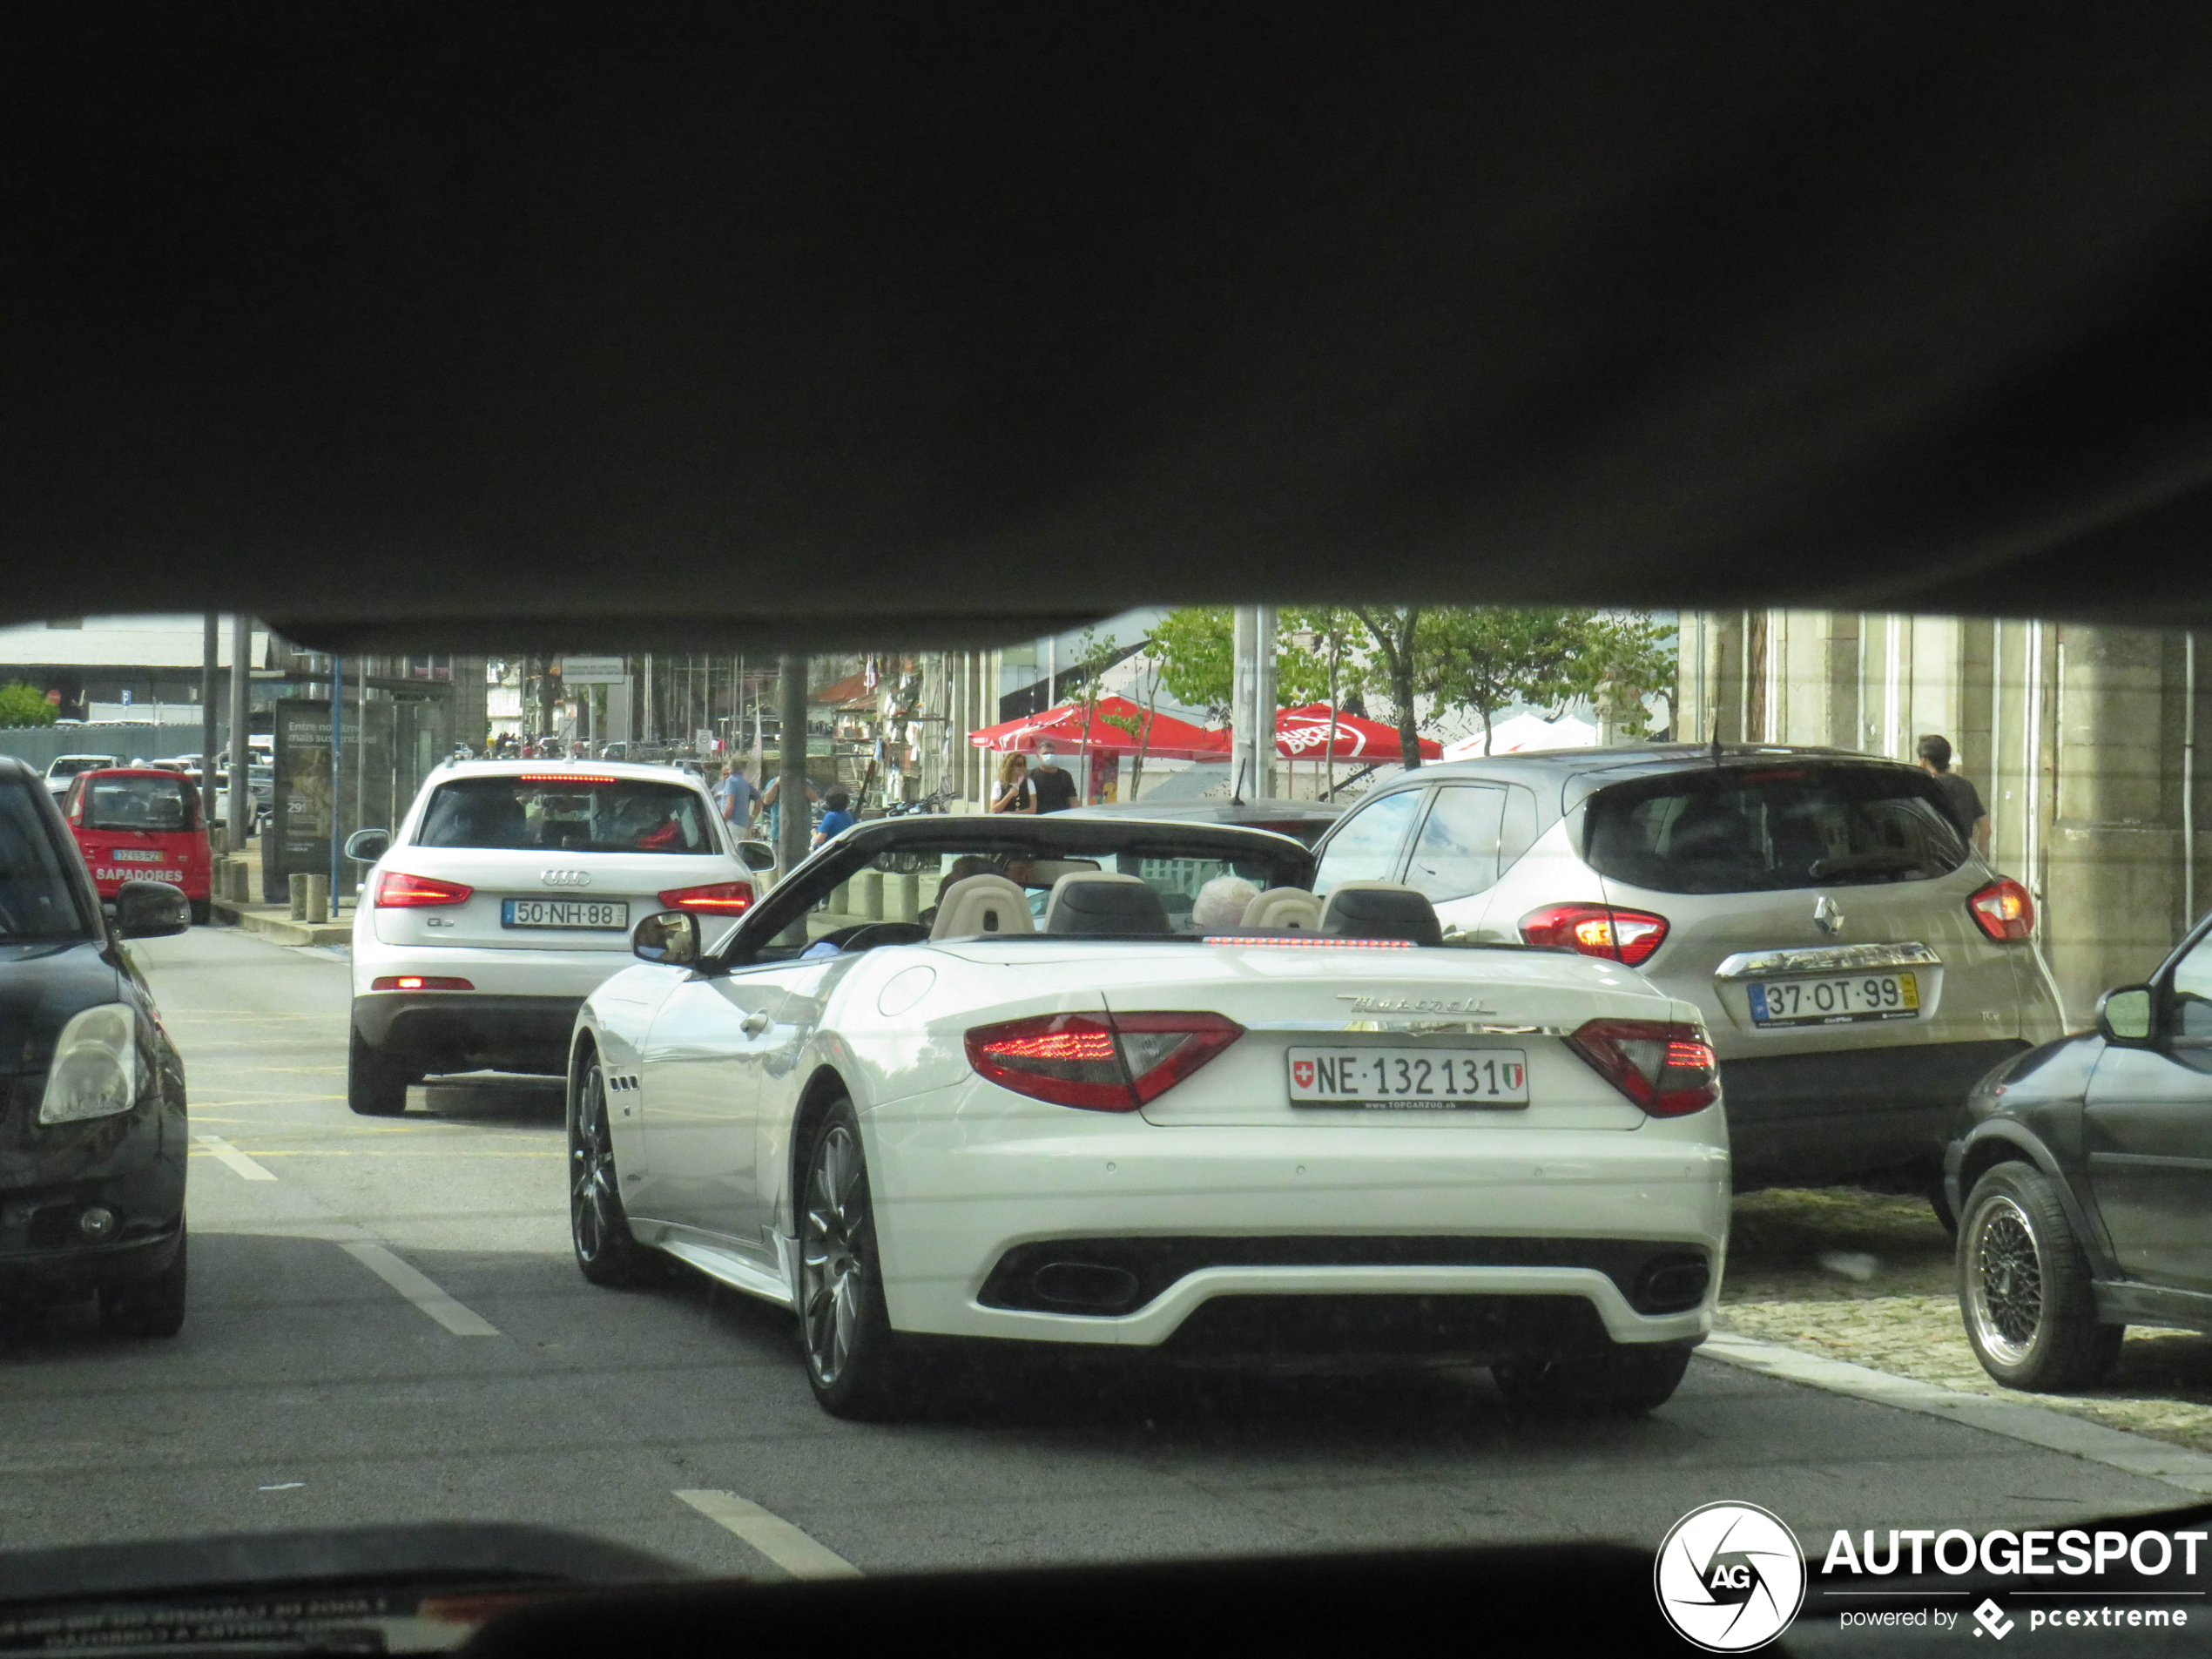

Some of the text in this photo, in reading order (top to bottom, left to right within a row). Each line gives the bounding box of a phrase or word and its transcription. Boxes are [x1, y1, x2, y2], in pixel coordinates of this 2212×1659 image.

[123, 691, 130, 705] P
[288, 722, 315, 732] Entre
[288, 733, 314, 742] mais
[96, 868, 183, 881] SAPADORES
